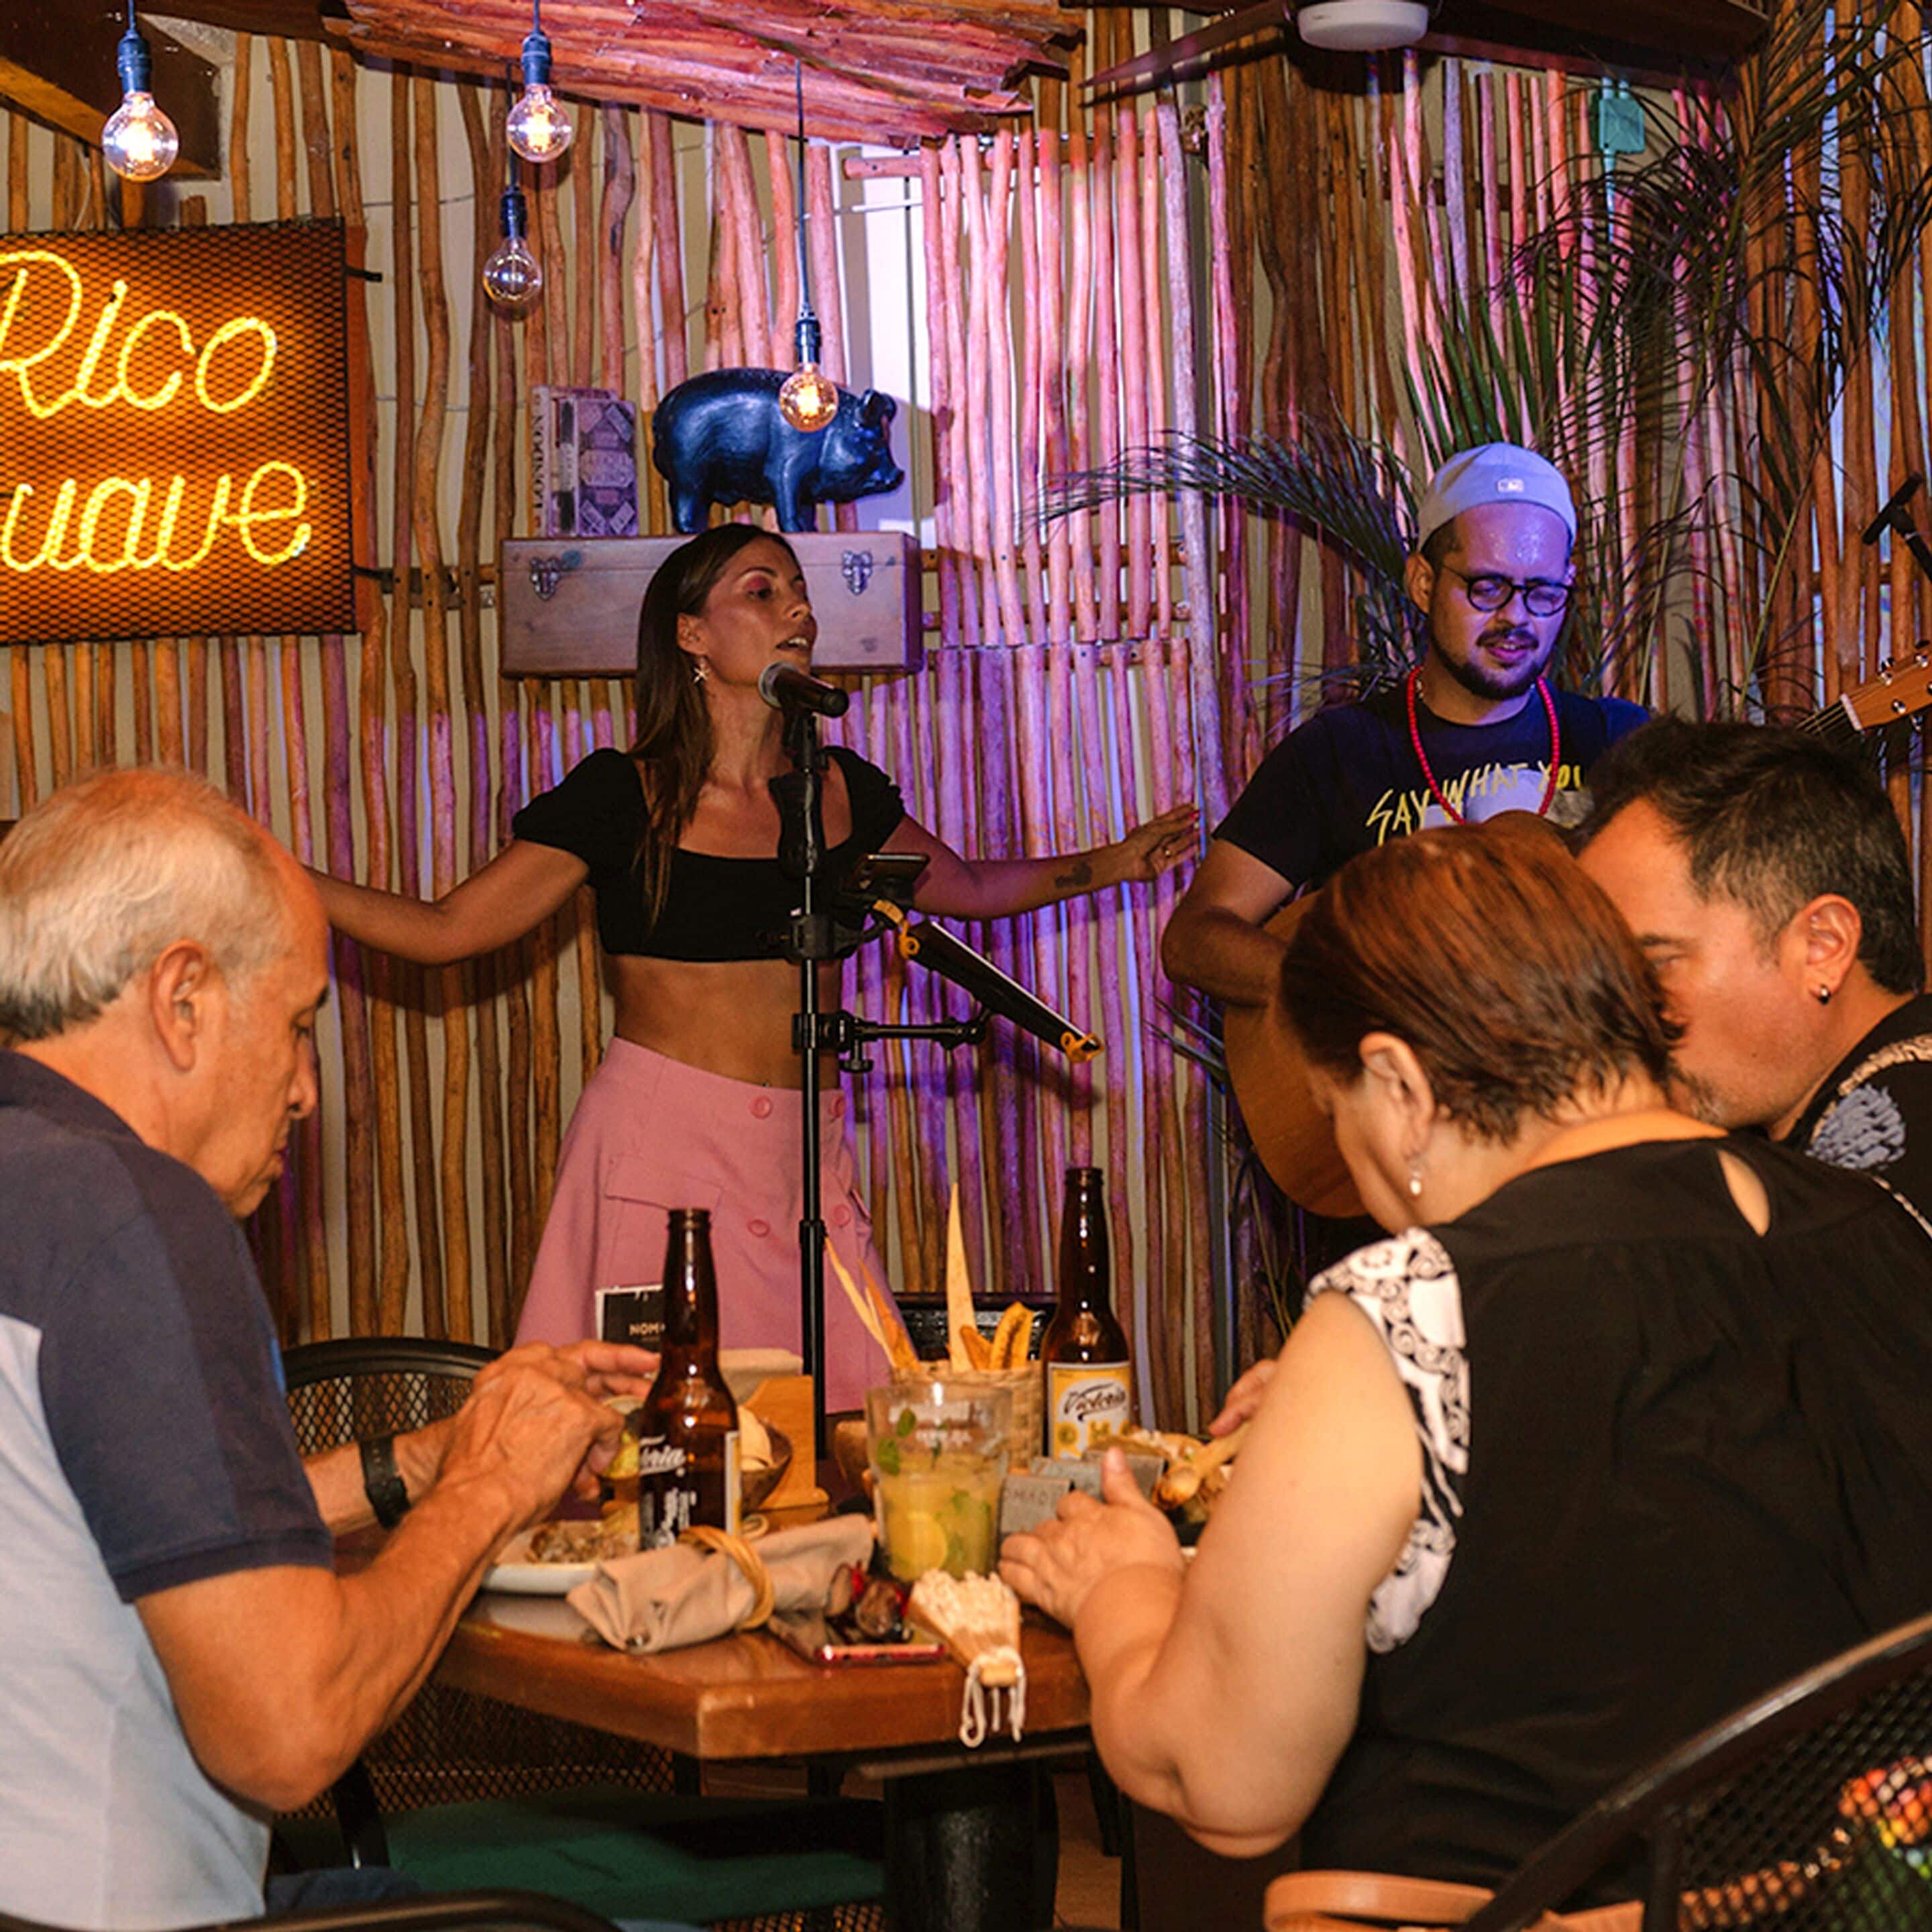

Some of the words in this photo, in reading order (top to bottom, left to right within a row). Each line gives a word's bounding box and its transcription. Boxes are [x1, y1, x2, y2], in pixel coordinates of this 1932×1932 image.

[0, 250, 277, 419] Rico
[533, 414, 545, 509] LONDON
[0, 461, 311, 572] uave
[1365, 788, 1432, 847] SAY
[1442, 762, 1528, 822] WHAT
